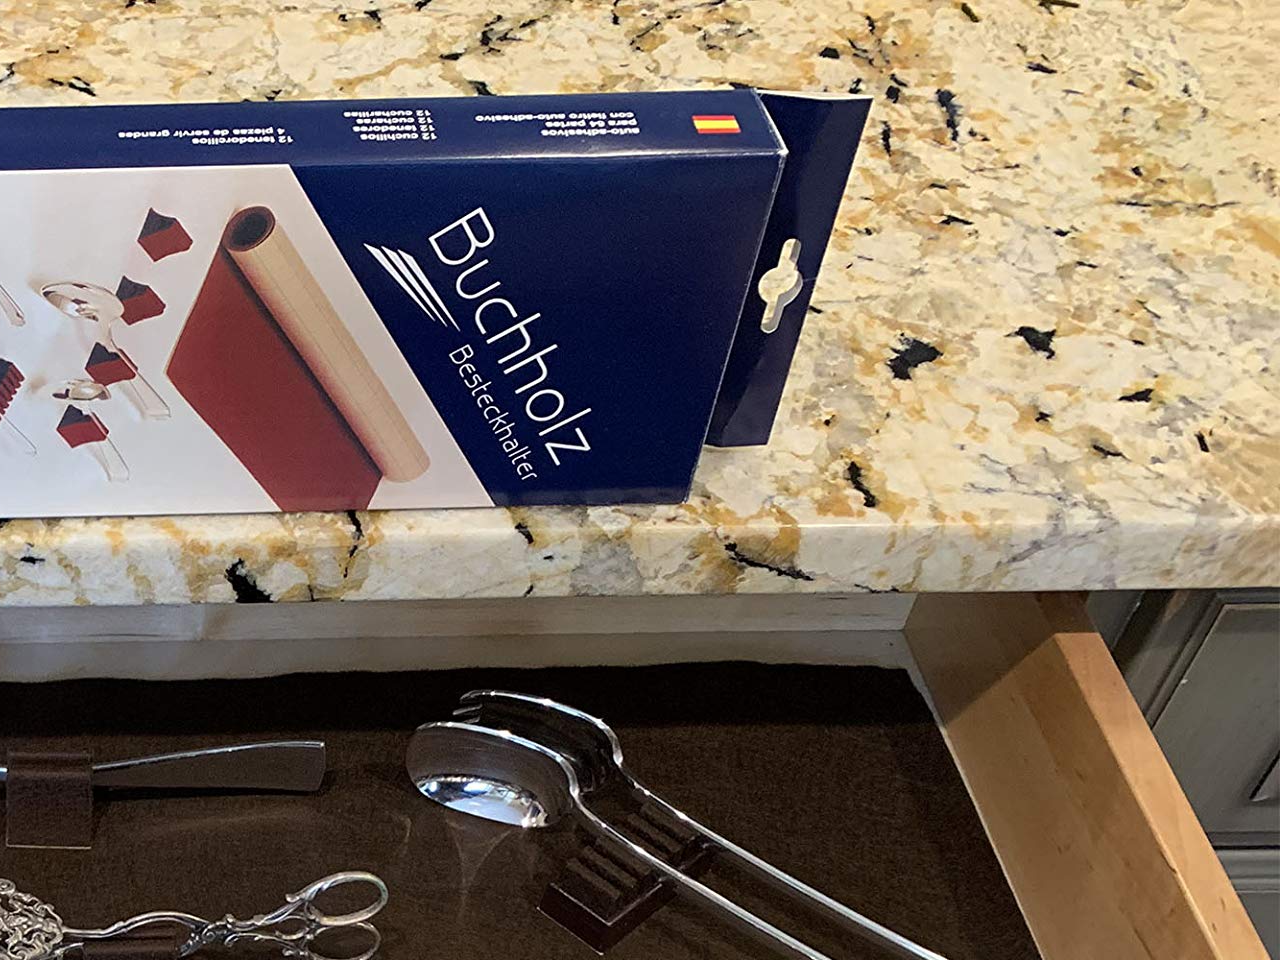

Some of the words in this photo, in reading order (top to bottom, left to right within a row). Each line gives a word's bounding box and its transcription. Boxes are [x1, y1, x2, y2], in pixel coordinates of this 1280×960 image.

[541, 128, 639, 136] auto-adhesivos
[428, 206, 592, 466] Buchholz
[448, 343, 538, 481] Besteckhalter
